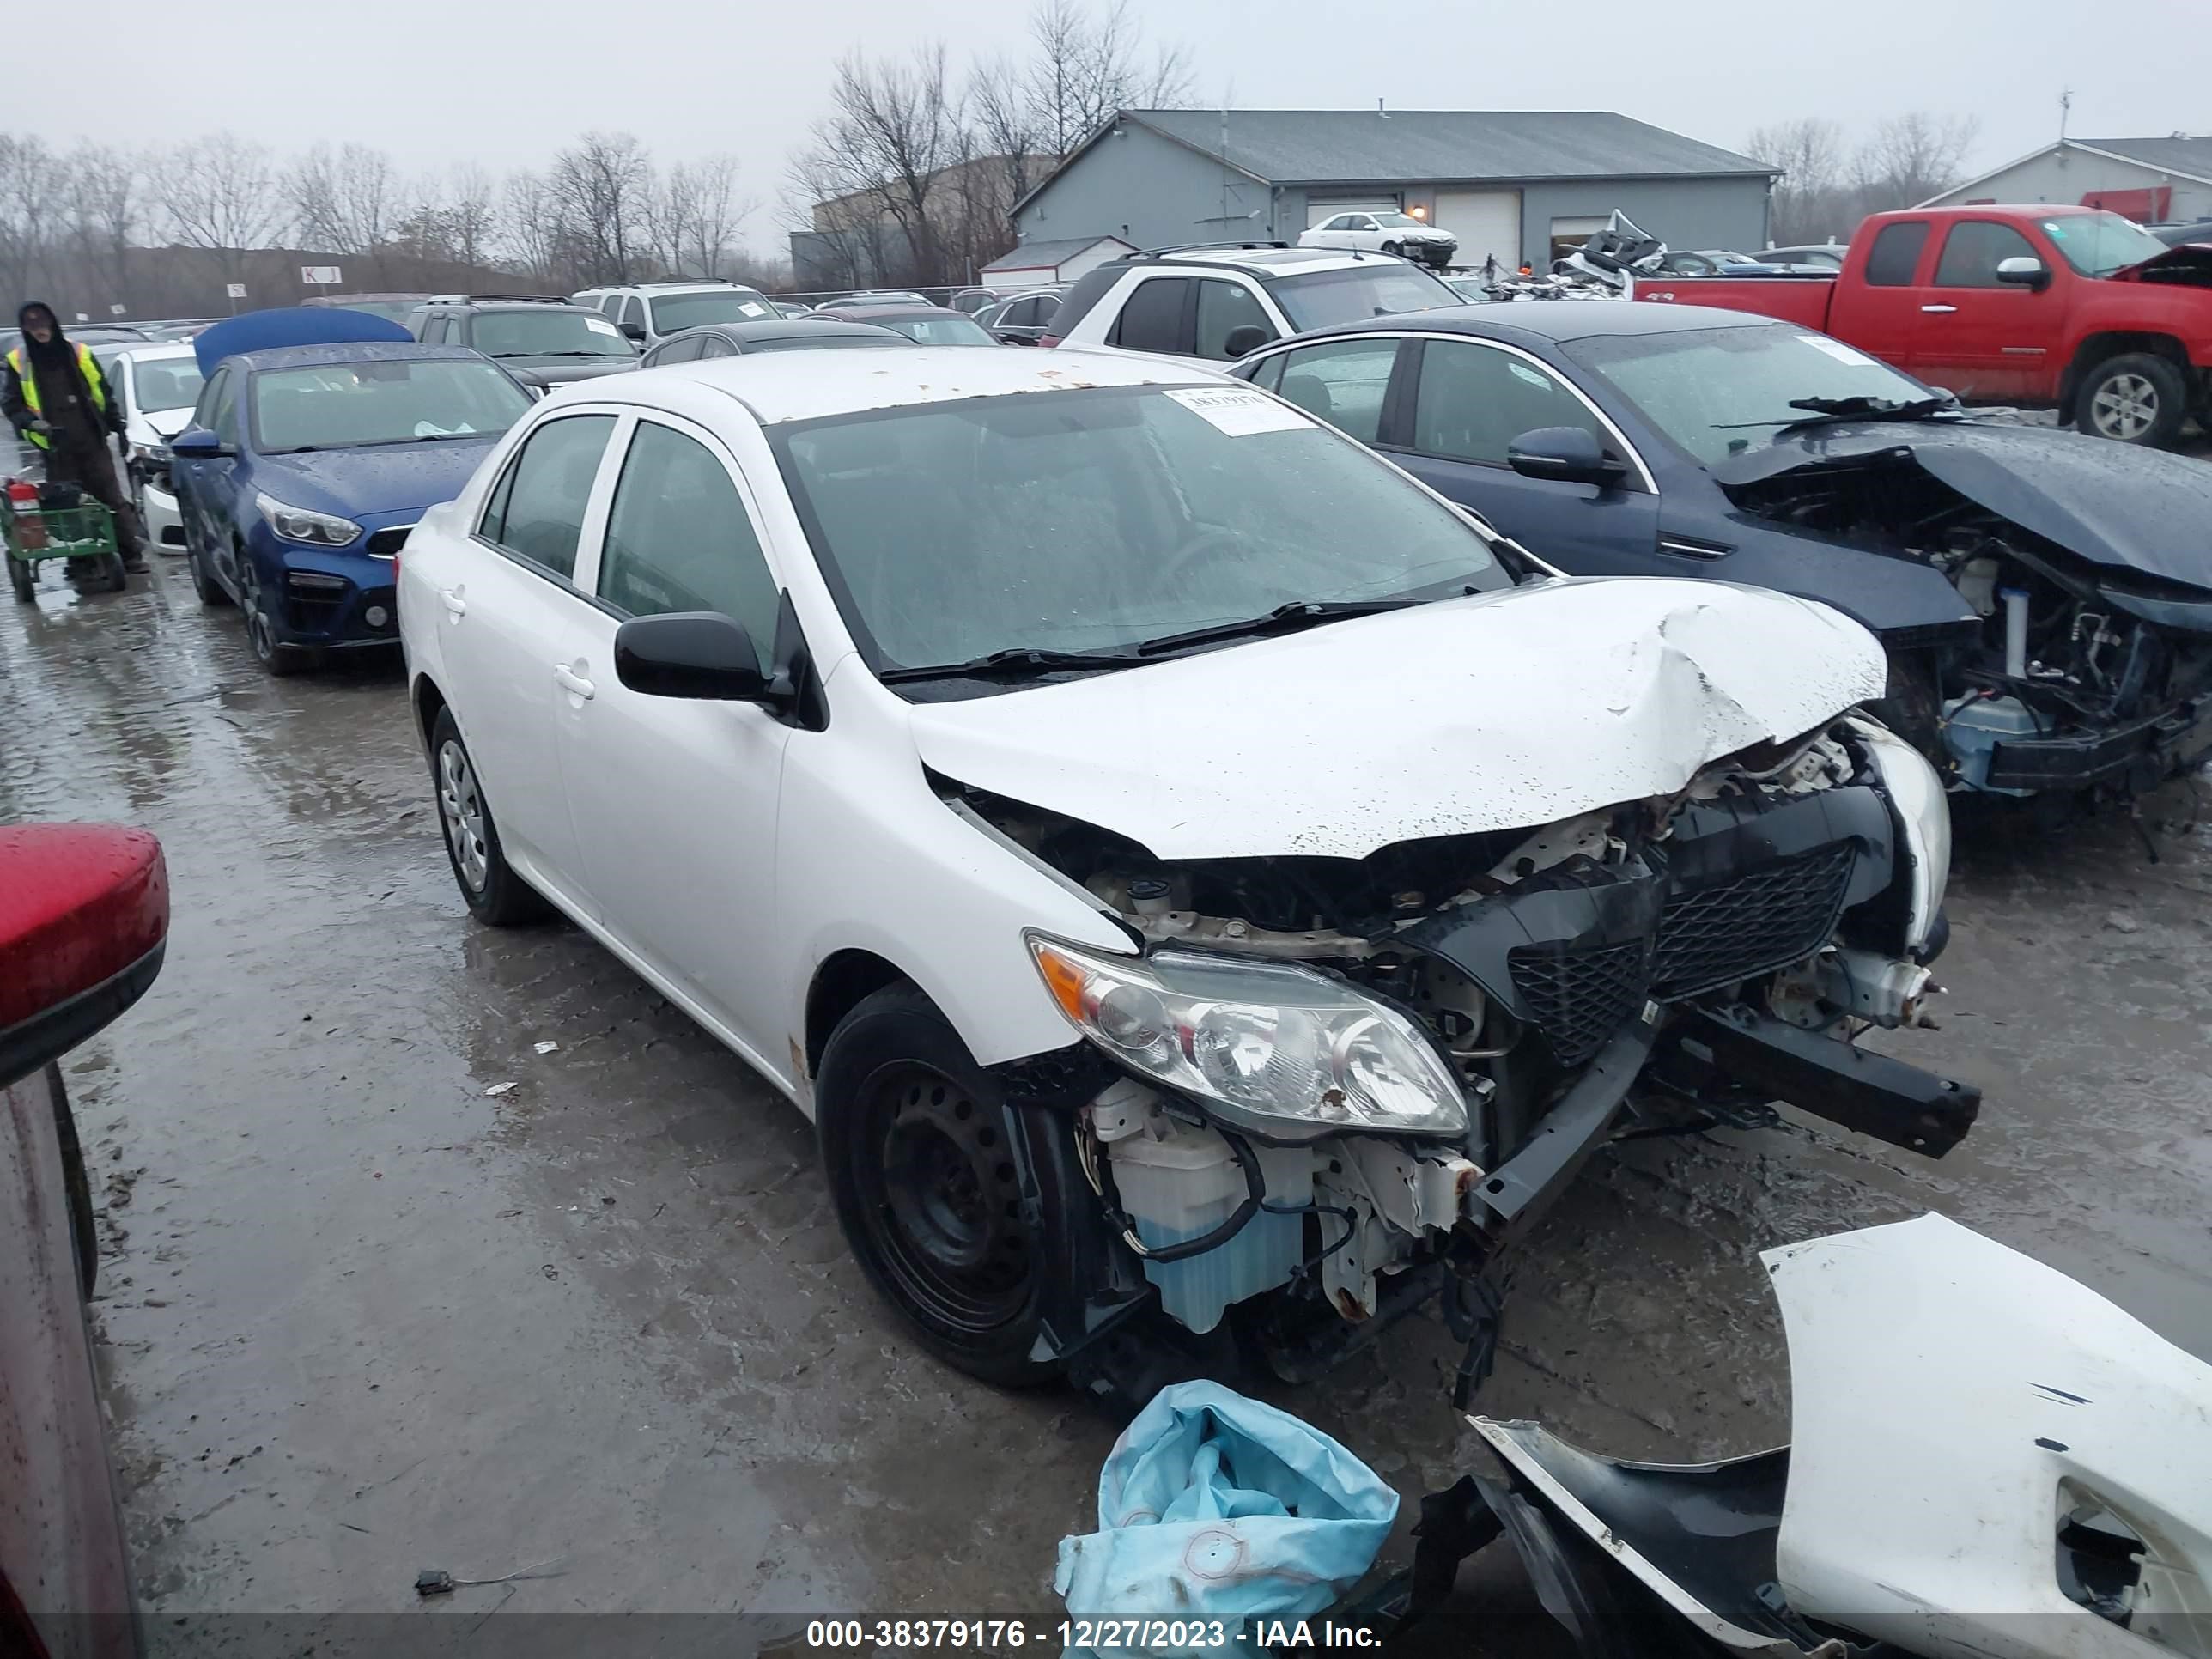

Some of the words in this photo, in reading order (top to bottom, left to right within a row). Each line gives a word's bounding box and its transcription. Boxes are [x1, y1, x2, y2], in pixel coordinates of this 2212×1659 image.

[305, 267, 317, 283] K
[329, 267, 337, 283] J
[1188, 396, 1265, 407] 38379176
